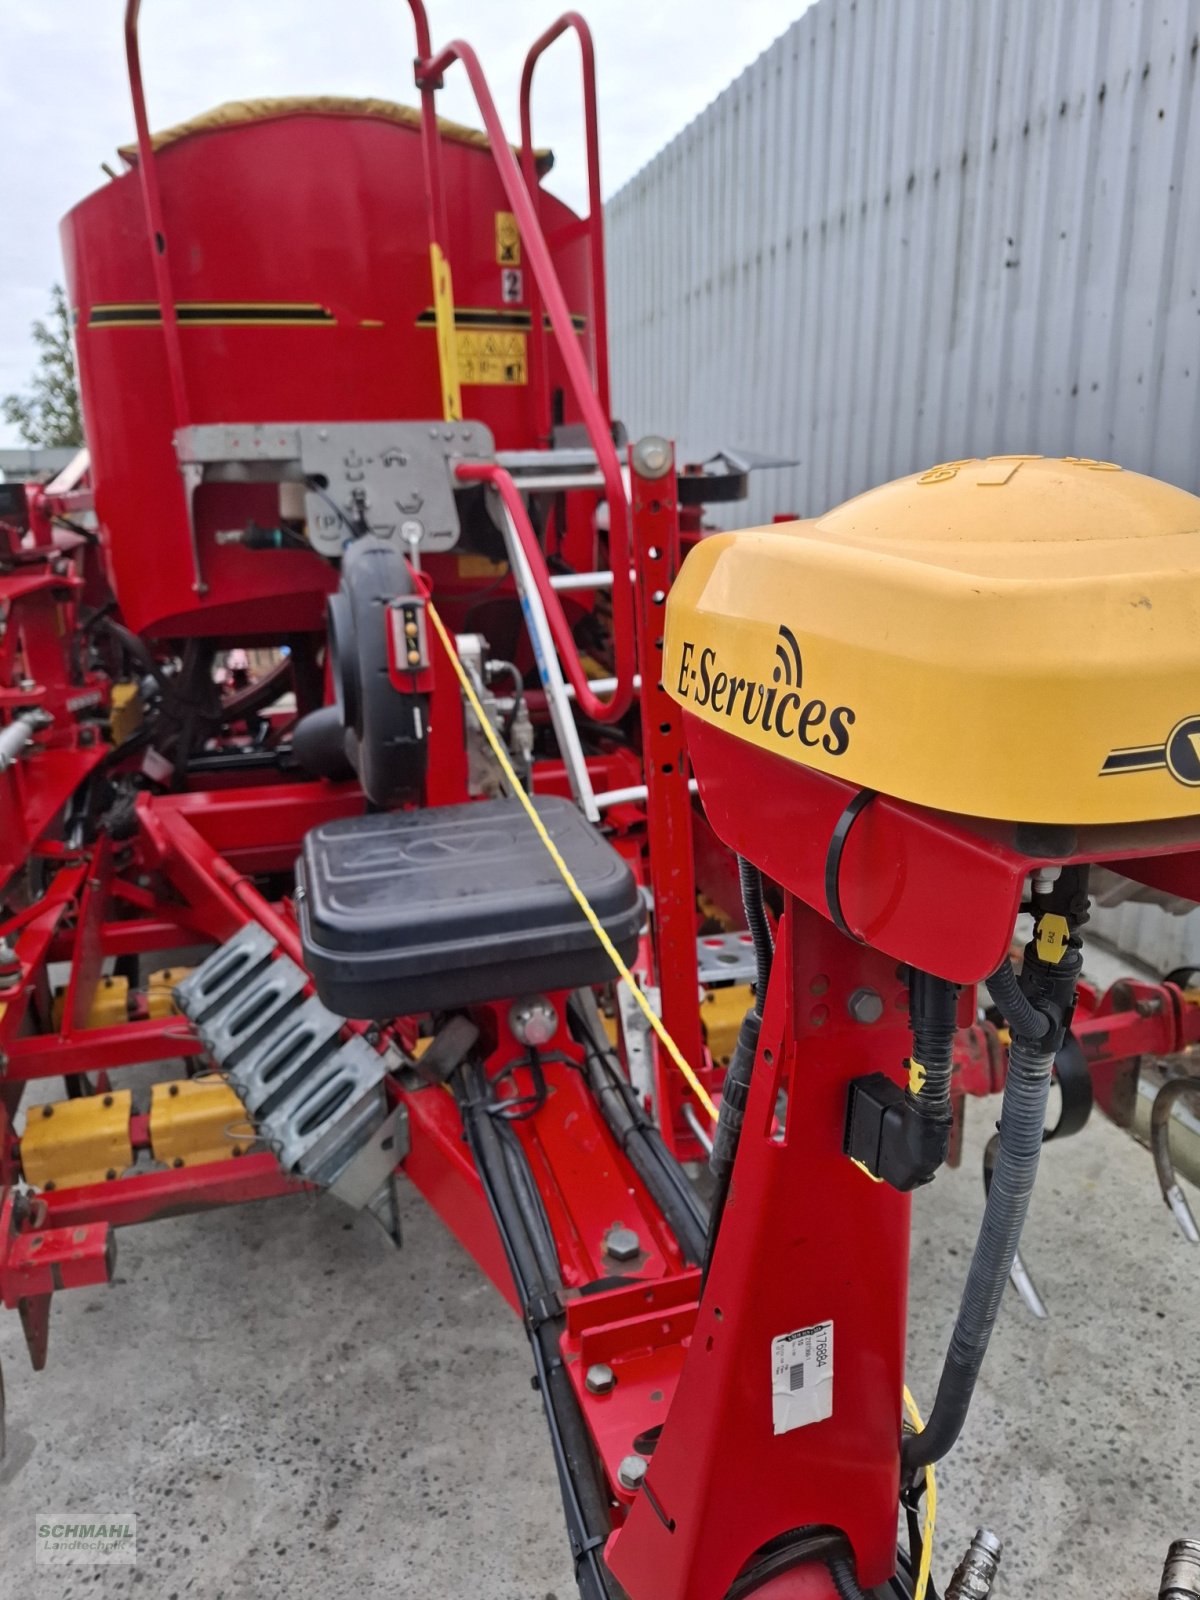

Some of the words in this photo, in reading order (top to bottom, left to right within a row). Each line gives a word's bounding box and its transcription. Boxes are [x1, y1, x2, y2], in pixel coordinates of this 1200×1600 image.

[506, 273, 518, 297] 2
[677, 641, 856, 756] E-Services
[815, 1331, 829, 1368] 176884
